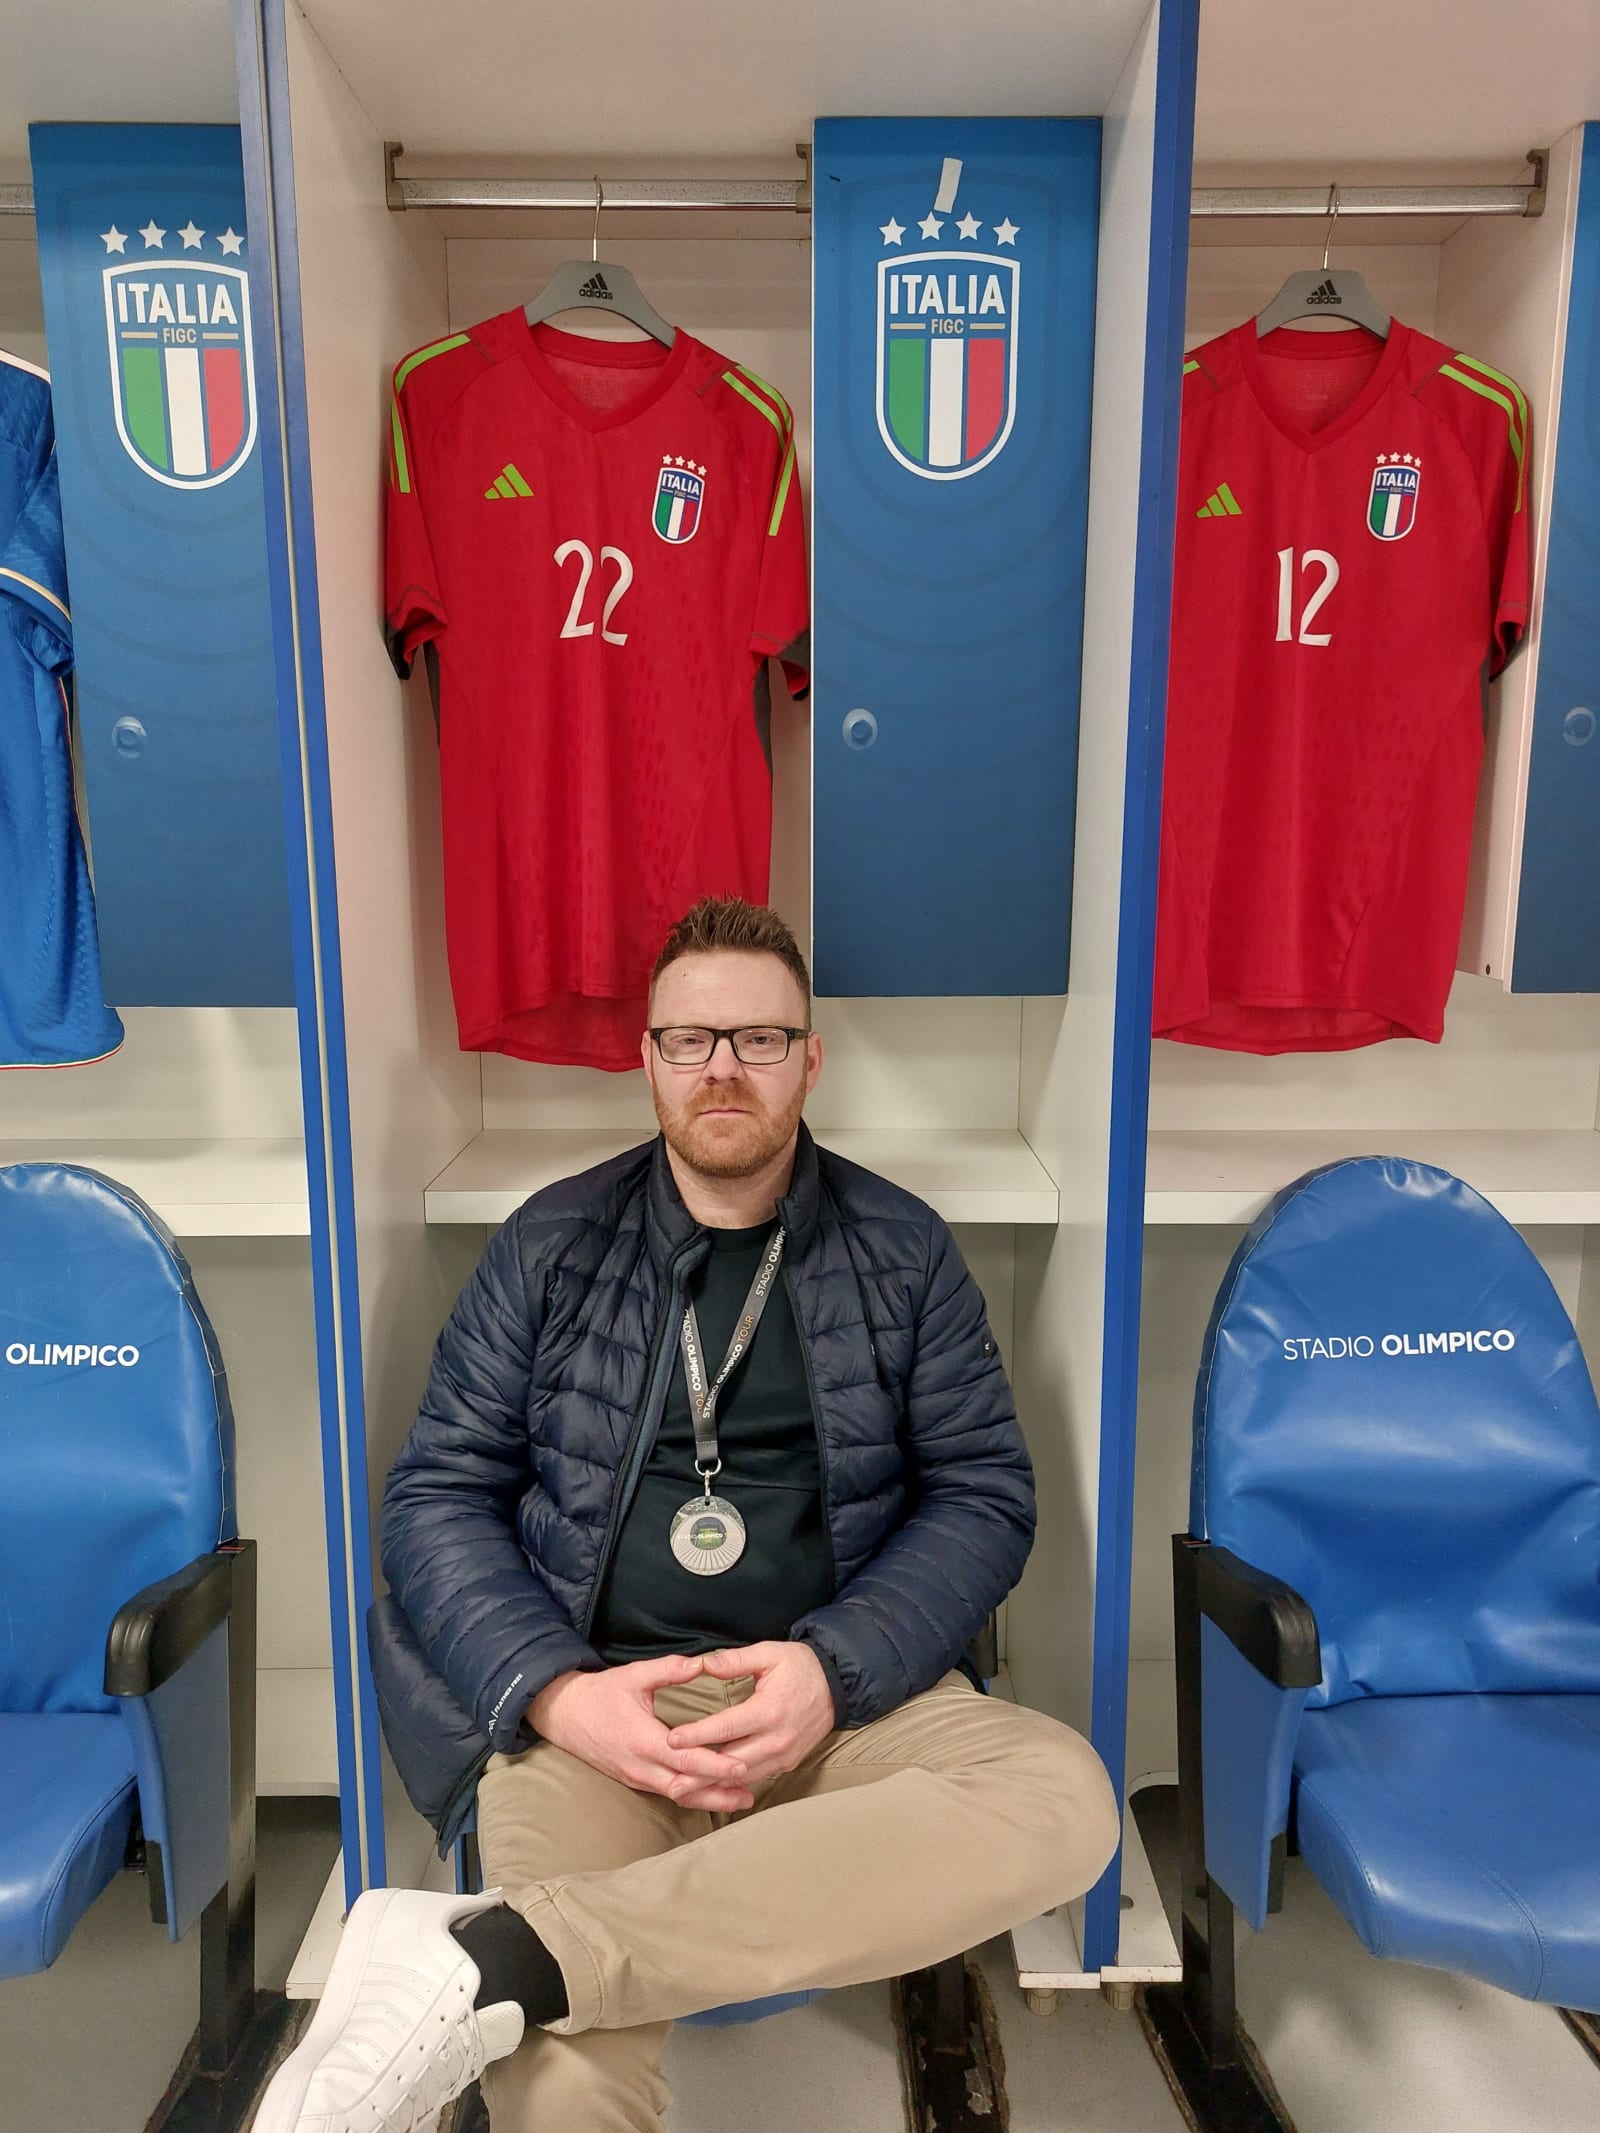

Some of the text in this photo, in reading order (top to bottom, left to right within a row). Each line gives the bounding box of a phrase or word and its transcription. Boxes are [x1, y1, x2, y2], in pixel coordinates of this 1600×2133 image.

[116, 282, 238, 325] ITALIA
[578, 287, 614, 301] adidas
[890, 274, 1006, 315] ITALIA
[1306, 294, 1342, 305] adidas
[162, 327, 197, 344] FIGC
[930, 318, 965, 334] FIGC
[661, 472, 700, 496] ITALIA
[1376, 471, 1416, 489] ITALIA
[553, 539, 634, 646] 22
[1275, 546, 1340, 647] 12
[755, 1262, 774, 1297] STADIO
[5, 1342, 140, 1367] OLIMPICO
[1283, 1328, 1516, 1361] STADIO OLIMPICO
[686, 1344, 702, 1391] OLIMPICO
[702, 1314, 756, 1419] STADIO OLIMPICO TOUR
[494, 1672, 524, 1714] FEATHER FREE
